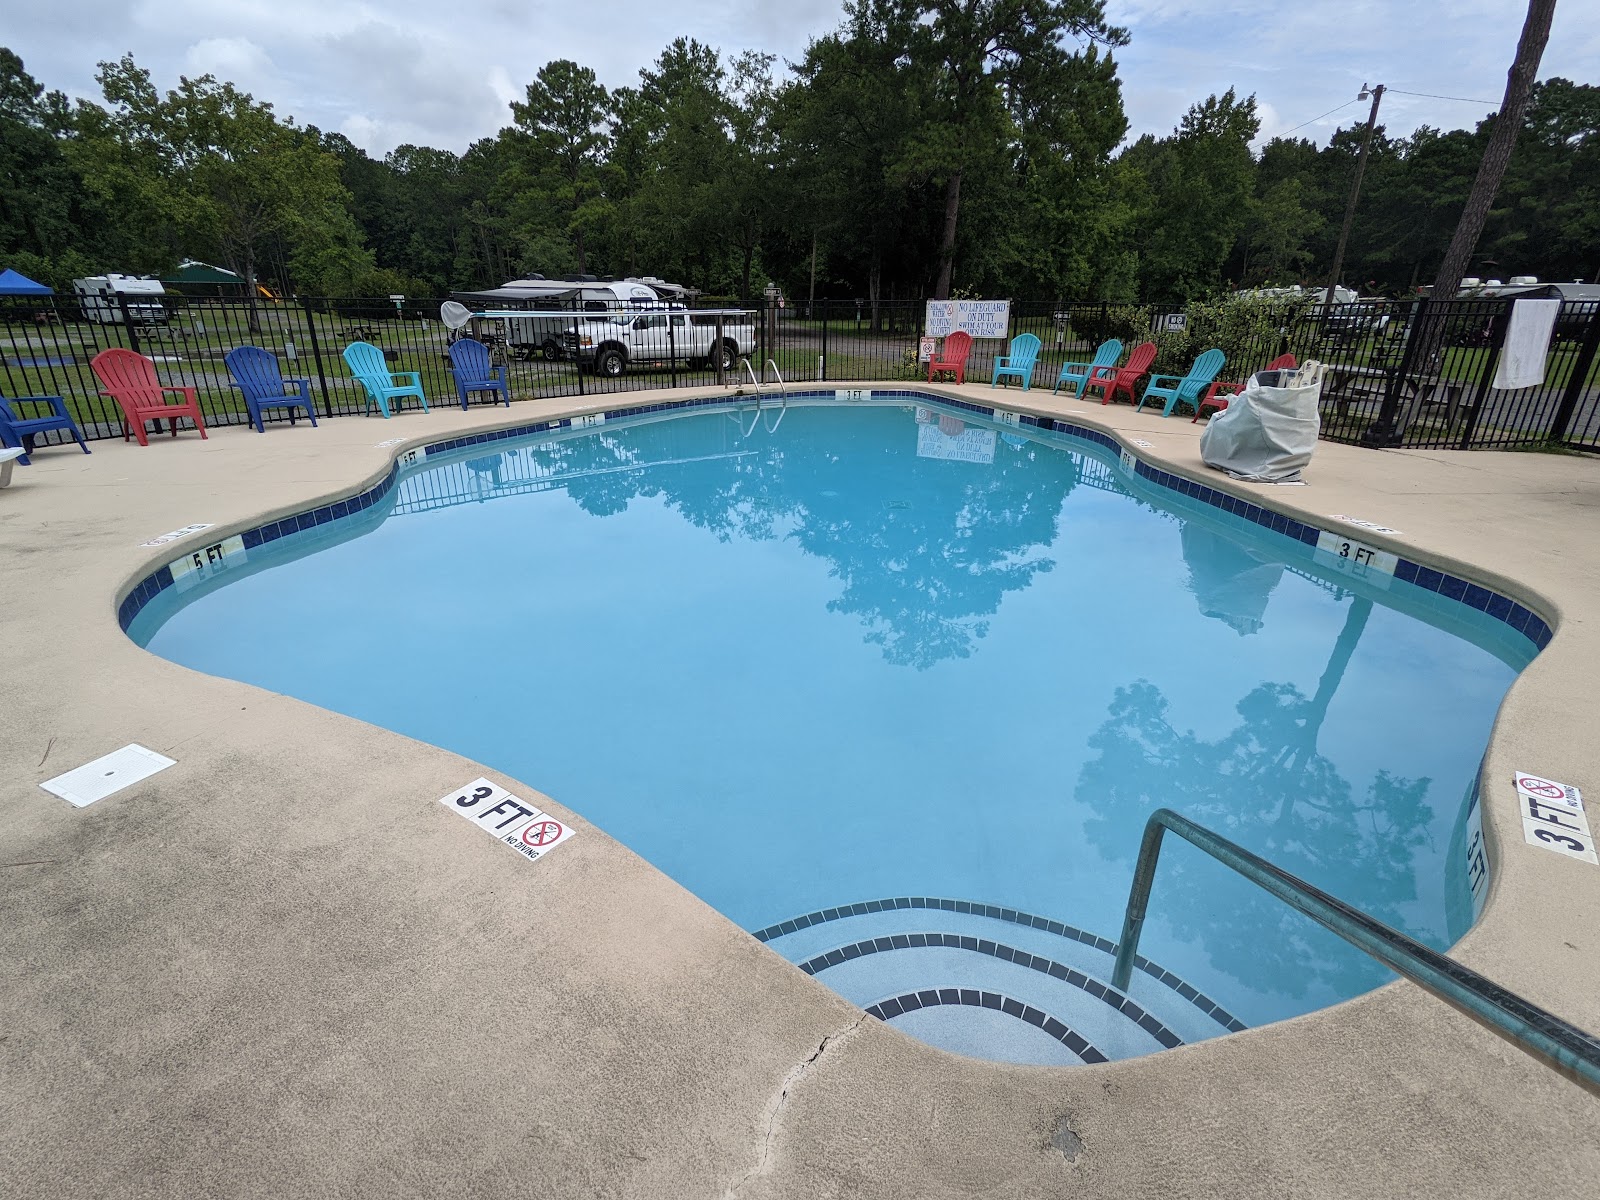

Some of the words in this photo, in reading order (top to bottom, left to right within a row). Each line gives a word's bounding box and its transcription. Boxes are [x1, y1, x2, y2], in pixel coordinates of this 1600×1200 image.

[959, 303, 968, 312] NO
[968, 302, 1006, 312] LIFEGUARD
[967, 313, 977, 322] ON
[978, 313, 995, 322] DUTY
[958, 321, 976, 329] SWIM
[986, 321, 1004, 329] YOUR
[965, 328, 980, 336] OWN
[193, 553, 203, 570] 5
[205, 543, 223, 565] FT
[1339, 542, 1351, 558] 3
[1354, 547, 1375, 566] FT
[456, 786, 493, 808] 3
[478, 799, 535, 830] FT
[1528, 797, 1581, 831] FT
[504, 835, 518, 845] NO
[514, 841, 540, 859] DIVING
[1467, 830, 1480, 861] 3
[1533, 829, 1585, 852] 3
[1468, 848, 1486, 892] FT
